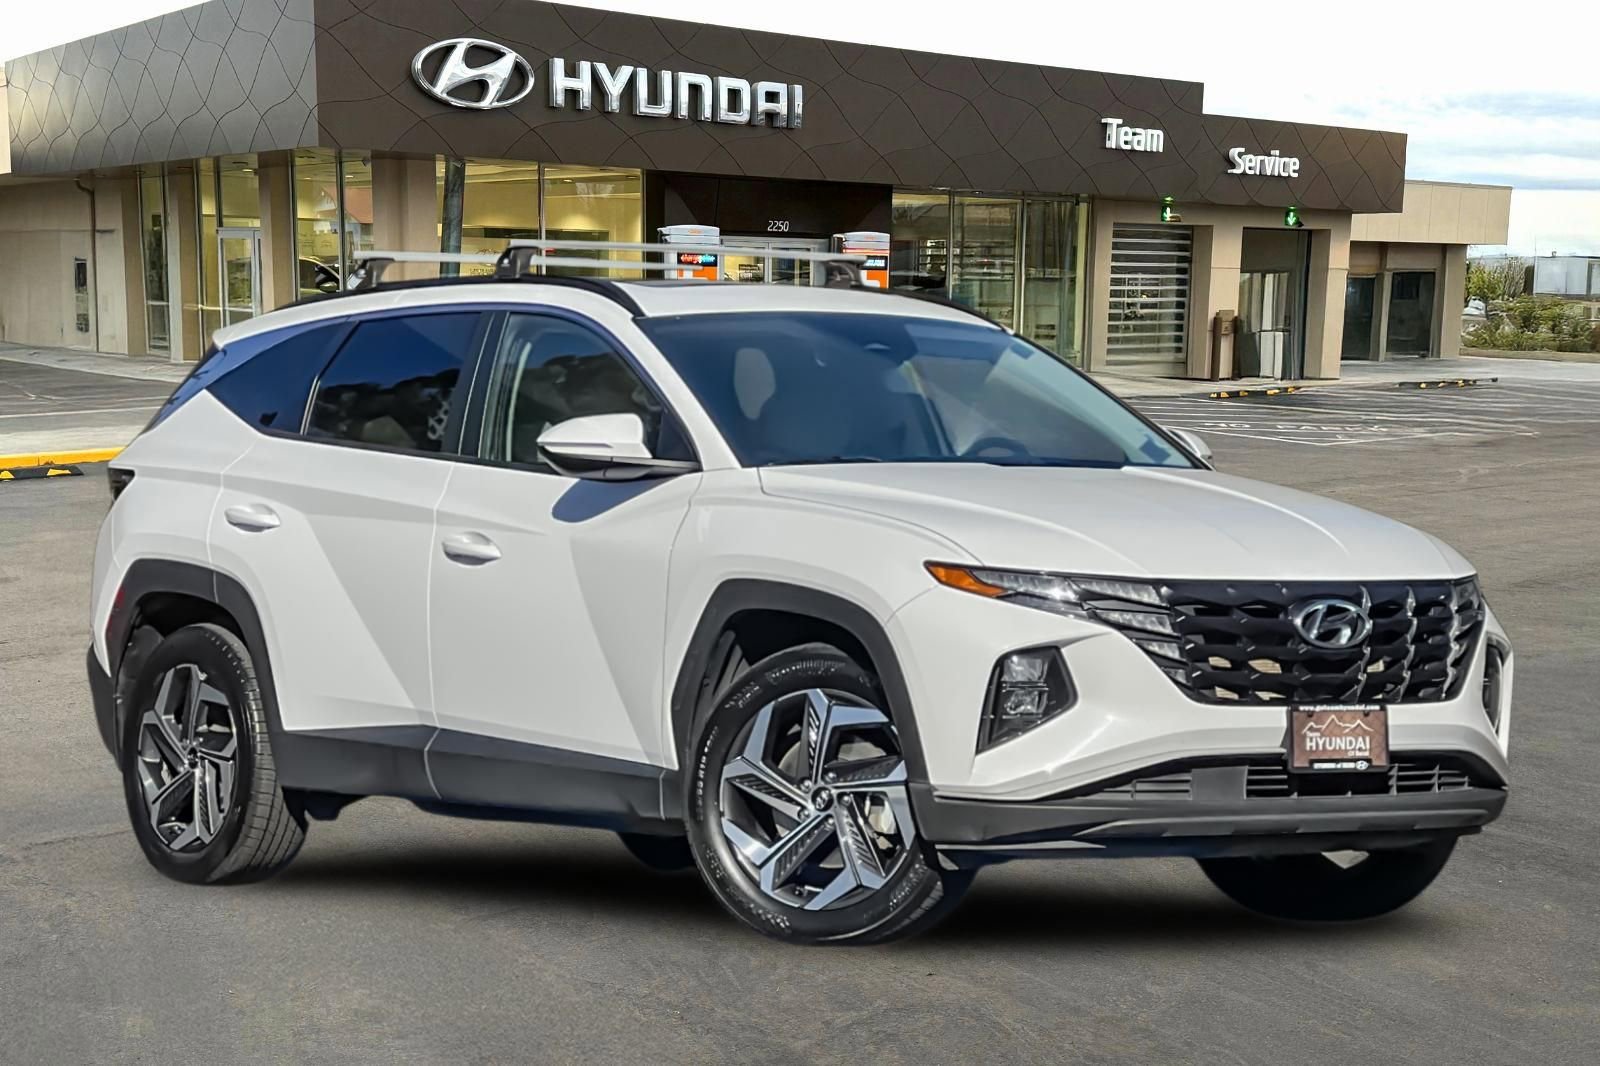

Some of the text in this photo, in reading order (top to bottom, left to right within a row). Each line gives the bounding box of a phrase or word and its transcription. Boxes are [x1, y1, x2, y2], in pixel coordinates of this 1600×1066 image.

[548, 57, 803, 129] HYUNDAI
[1101, 118, 1164, 152] Team
[1227, 147, 1300, 178] Service
[767, 220, 790, 232] 2250
[1306, 736, 1370, 751] HYUNDAI
